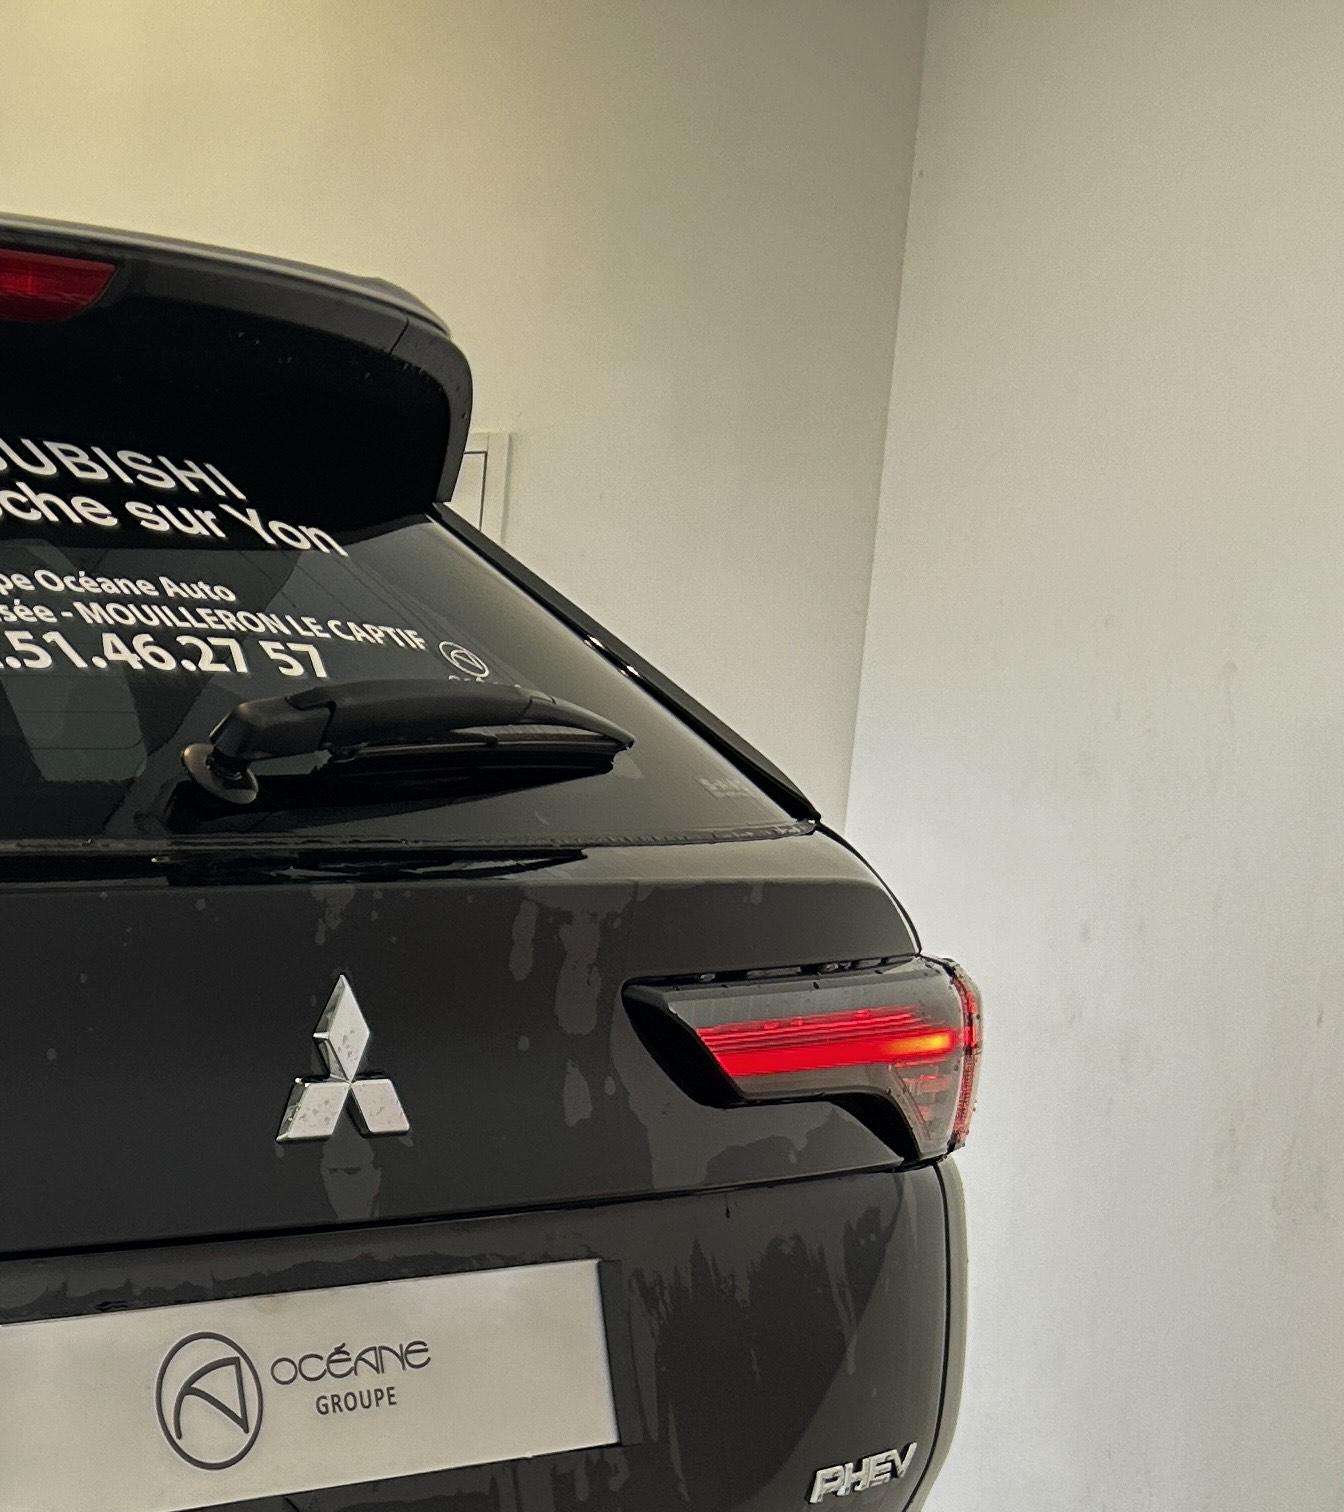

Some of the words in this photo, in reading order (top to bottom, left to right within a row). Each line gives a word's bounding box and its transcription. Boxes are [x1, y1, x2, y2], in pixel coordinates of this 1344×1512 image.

[124, 501, 226, 538] sur
[218, 503, 349, 557] Yon
[33, 570, 160, 597] Océane
[158, 576, 237, 602] Auto
[72, 600, 292, 635] MOUILLERON
[284, 614, 332, 639] LE
[326, 619, 427, 651] CAPTIF
[258, 639, 328, 679] 57
[315, 1386, 399, 1416] GROUPE
[808, 1441, 918, 1504] PHEV
